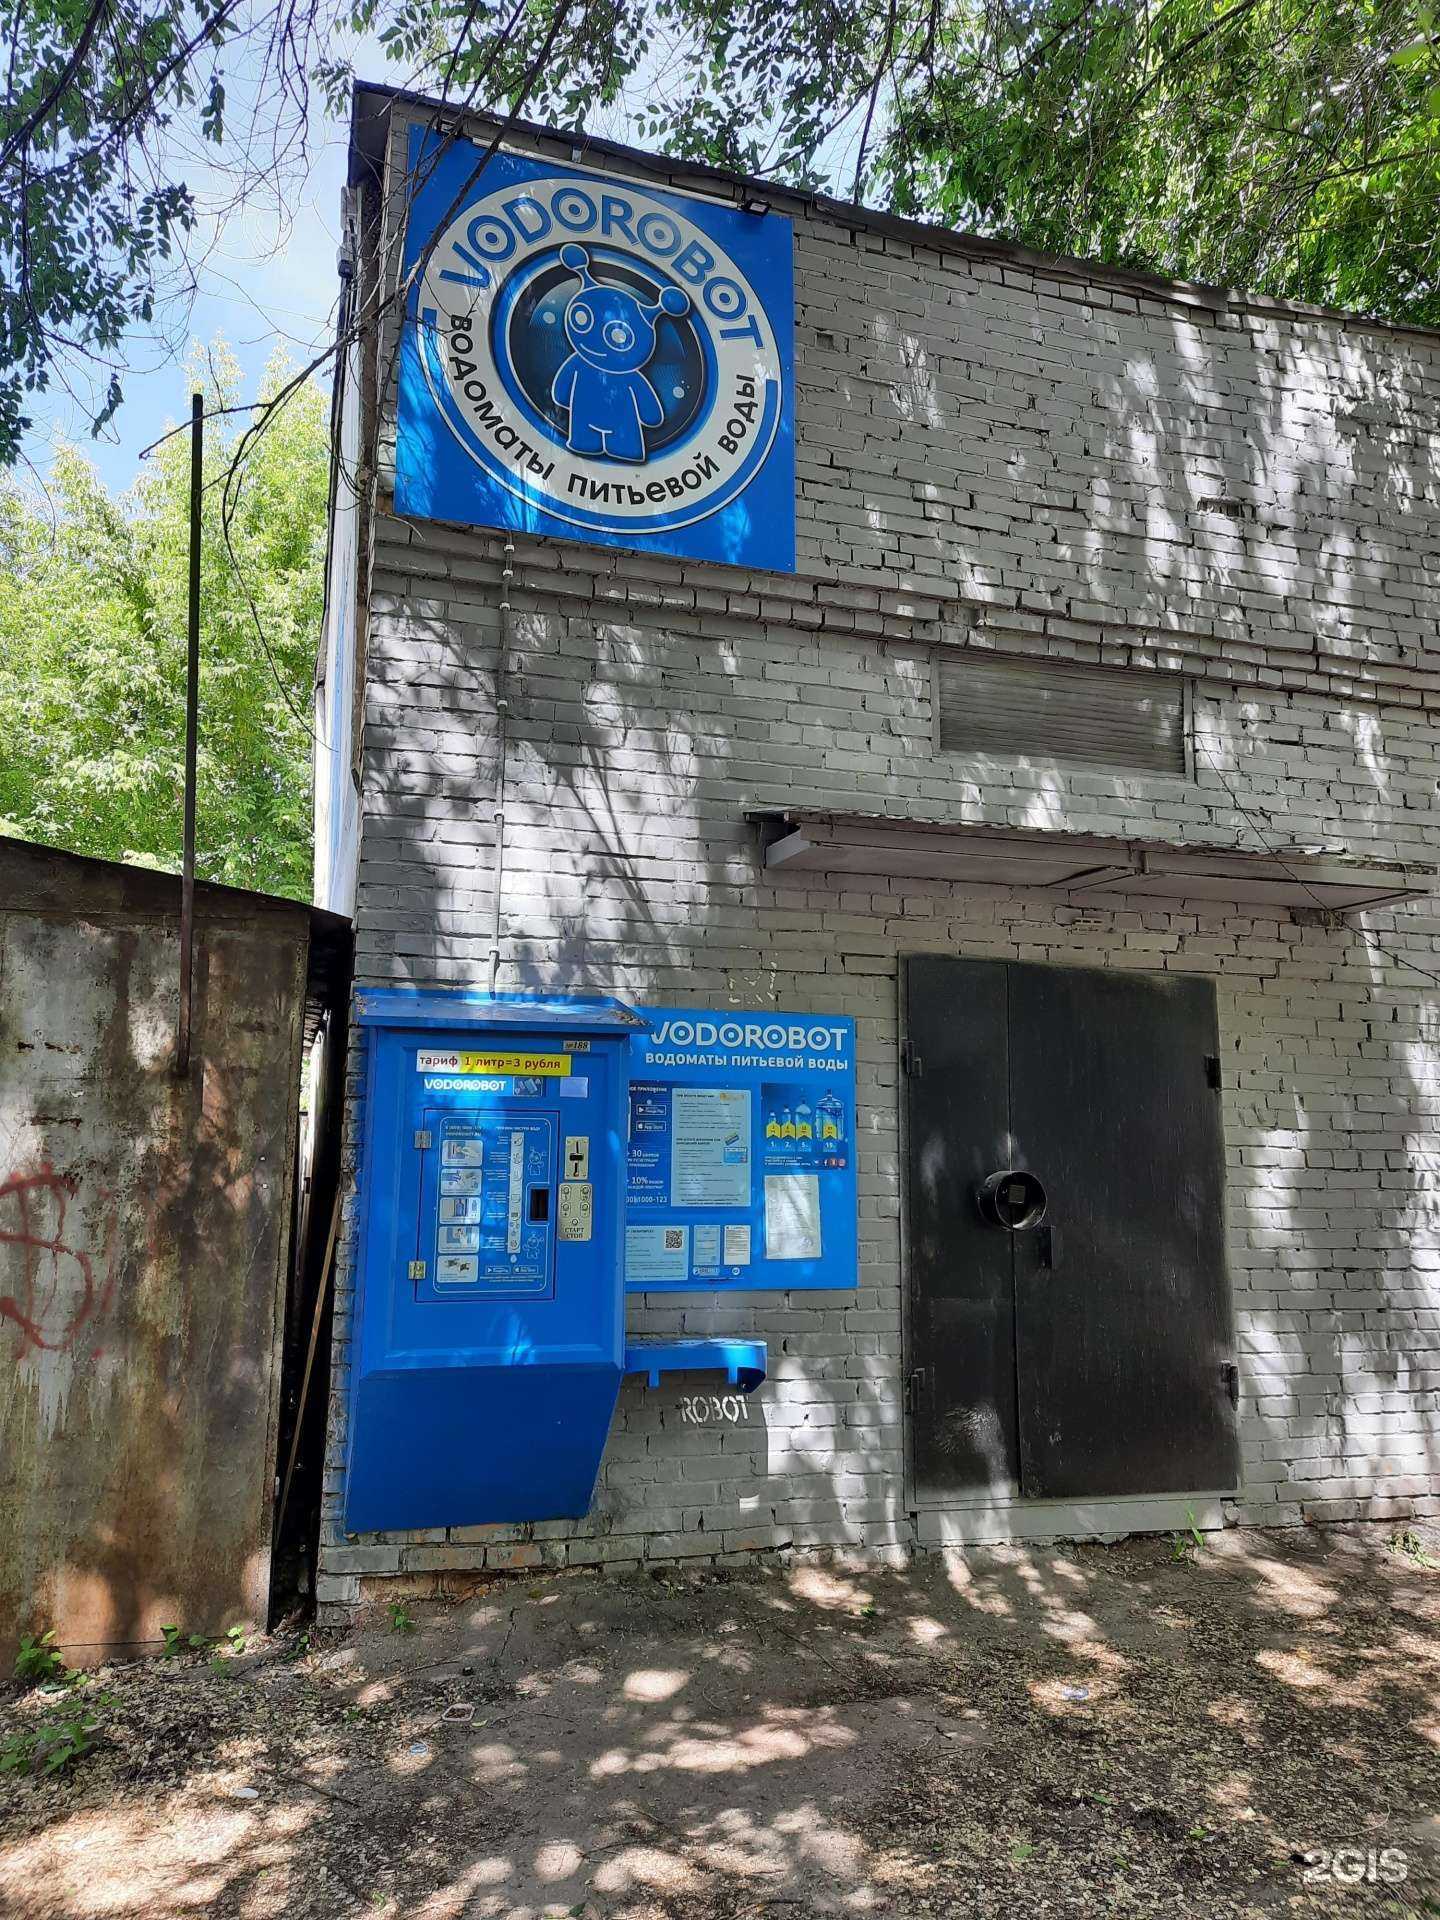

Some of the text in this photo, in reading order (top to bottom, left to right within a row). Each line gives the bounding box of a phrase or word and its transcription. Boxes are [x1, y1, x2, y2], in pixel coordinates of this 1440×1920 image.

[439, 187, 763, 350] VODOROBOT
[650, 1020, 848, 1052] VODOROBOT
[419, 1055, 458, 1068] тариф
[465, 1056, 471, 1066] 1
[524, 1058, 561, 1070] рубля
[645, 1052, 848, 1071] ВОДОМАТЫ ПИТЬЕВОЙ ВОДЫ
[423, 1078, 507, 1092] VODOROBOT
[681, 1395, 748, 1423] ROBOT
